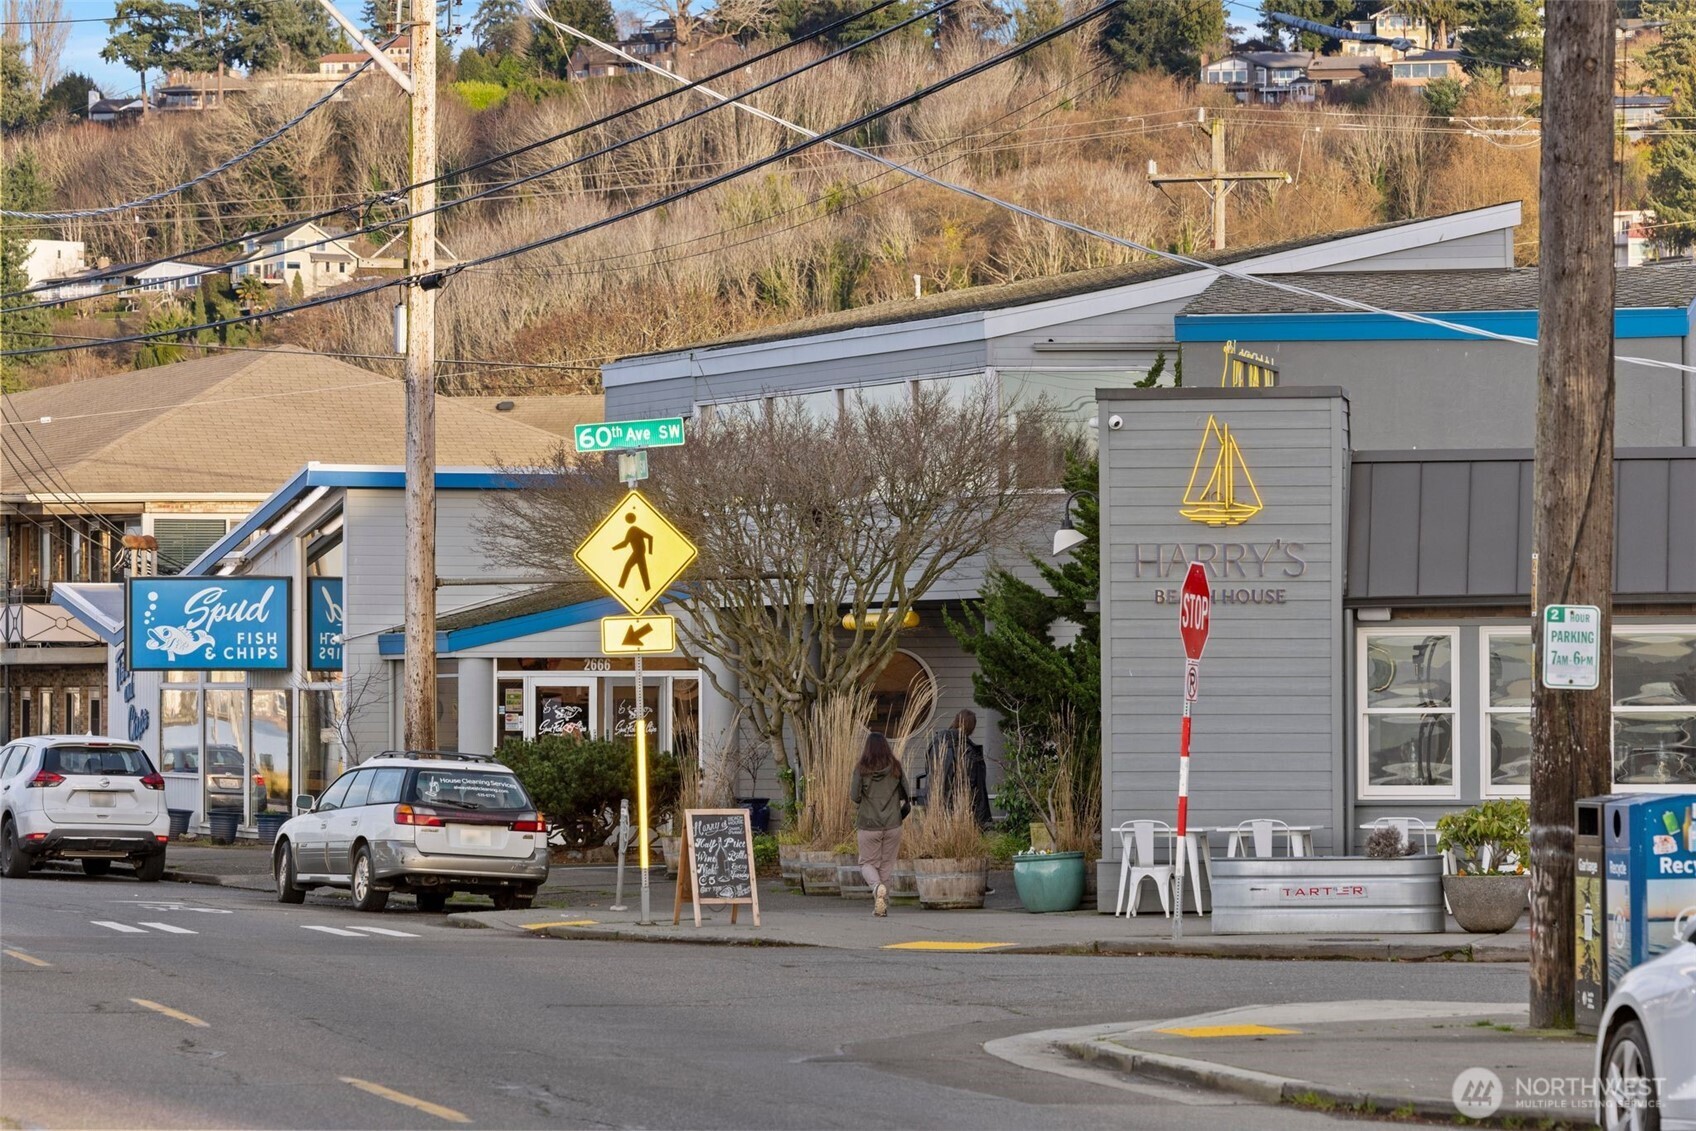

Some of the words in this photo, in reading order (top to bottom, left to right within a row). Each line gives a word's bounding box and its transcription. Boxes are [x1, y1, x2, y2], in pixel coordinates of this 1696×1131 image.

[578, 425, 623, 449] 60th
[626, 427, 650, 442] Ave
[658, 424, 680, 439] SW
[1135, 539, 1306, 578] HARRY'S
[1222, 589, 1287, 605] HOUSE
[184, 585, 275, 632] Spud
[1182, 592, 1208, 630] STOP
[1550, 609, 1560, 620] 2
[1570, 614, 1591, 623] HOUR
[237, 632, 277, 644] FISH
[1551, 630, 1595, 644] PARKING
[205, 647, 216, 660] &
[223, 646, 278, 660] CHIPS
[584, 658, 611, 671] 2666
[461, 778, 491, 787] Cleaning
[491, 780, 517, 790] Services
[1578, 857, 1598, 875] Garbage
[1609, 860, 1628, 877] Recycle
